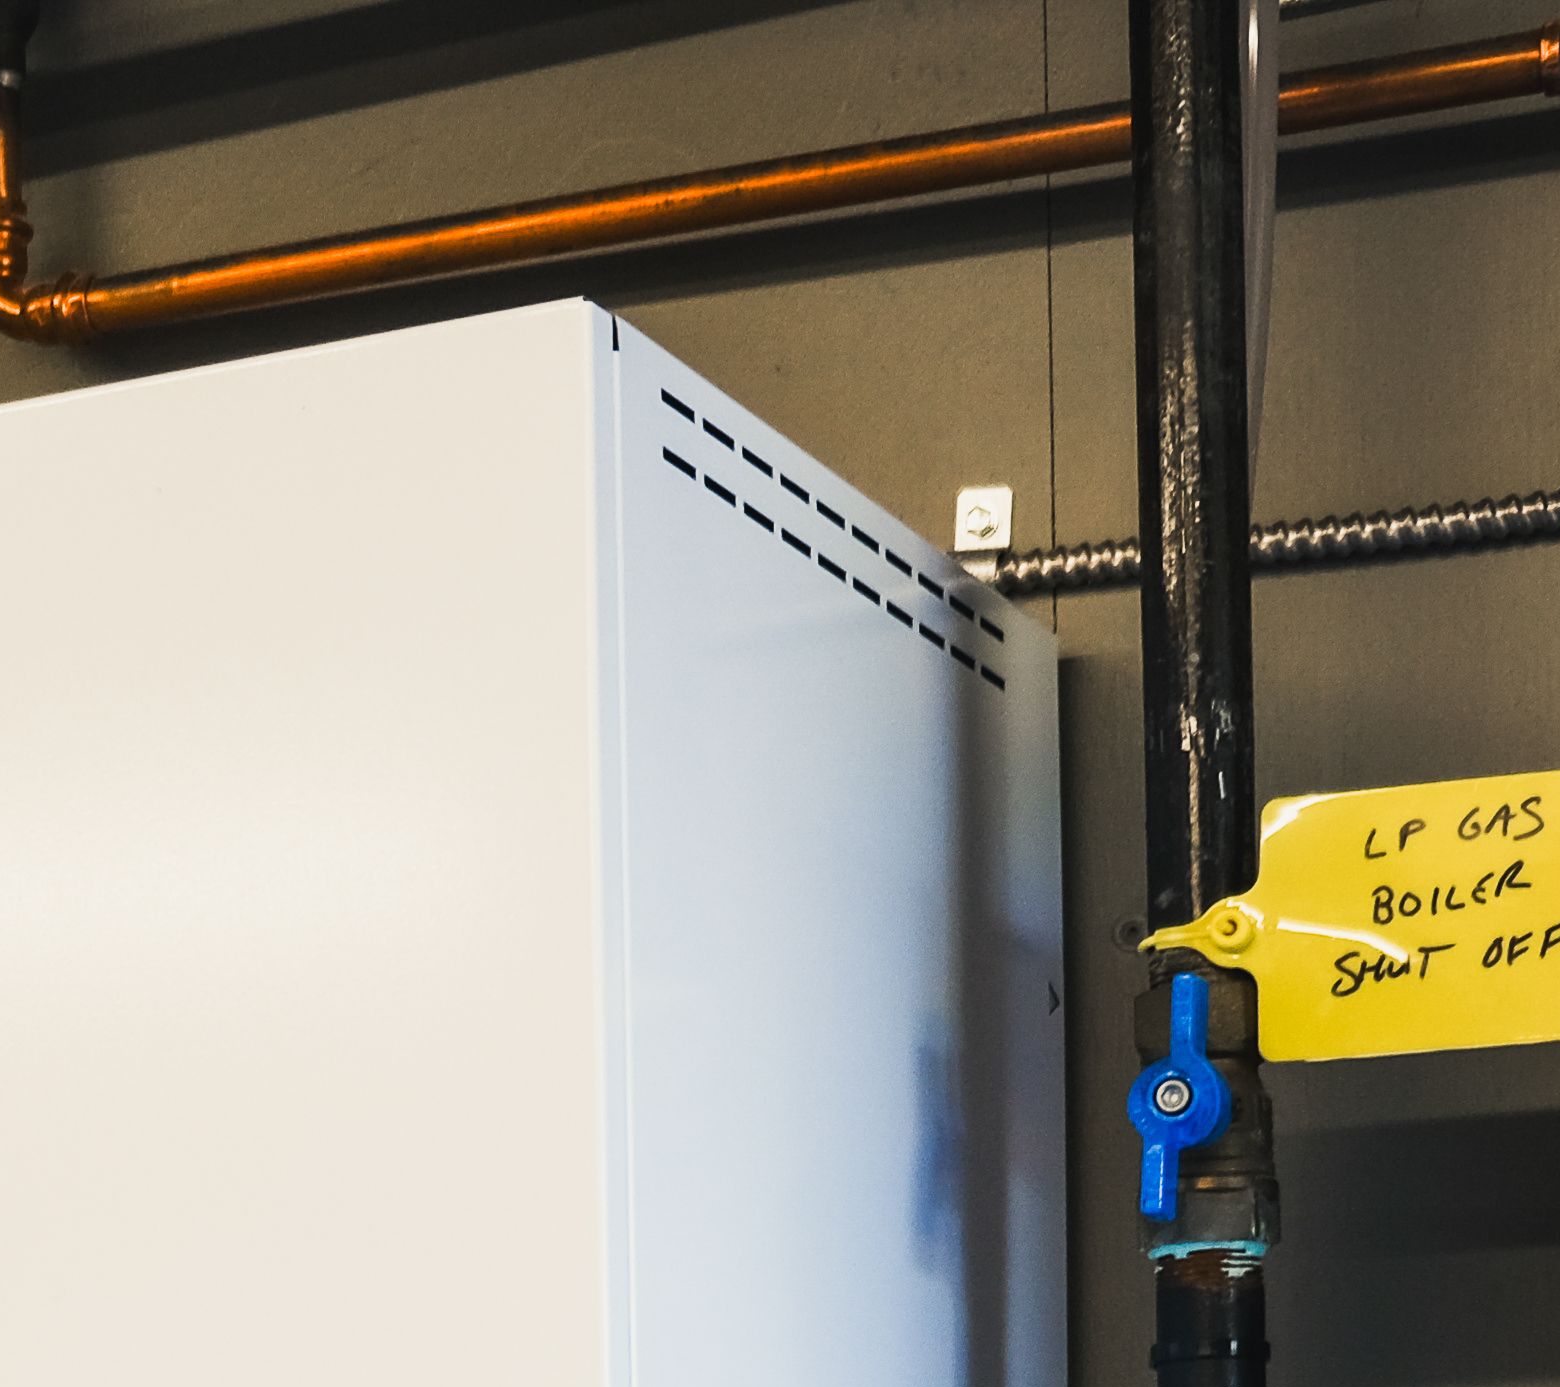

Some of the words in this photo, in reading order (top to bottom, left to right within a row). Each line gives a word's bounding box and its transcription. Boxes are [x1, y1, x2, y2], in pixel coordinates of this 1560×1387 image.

[1364, 818, 1427, 859] LP
[1457, 796, 1546, 840] GAS
[1372, 859, 1532, 925] BOILER
